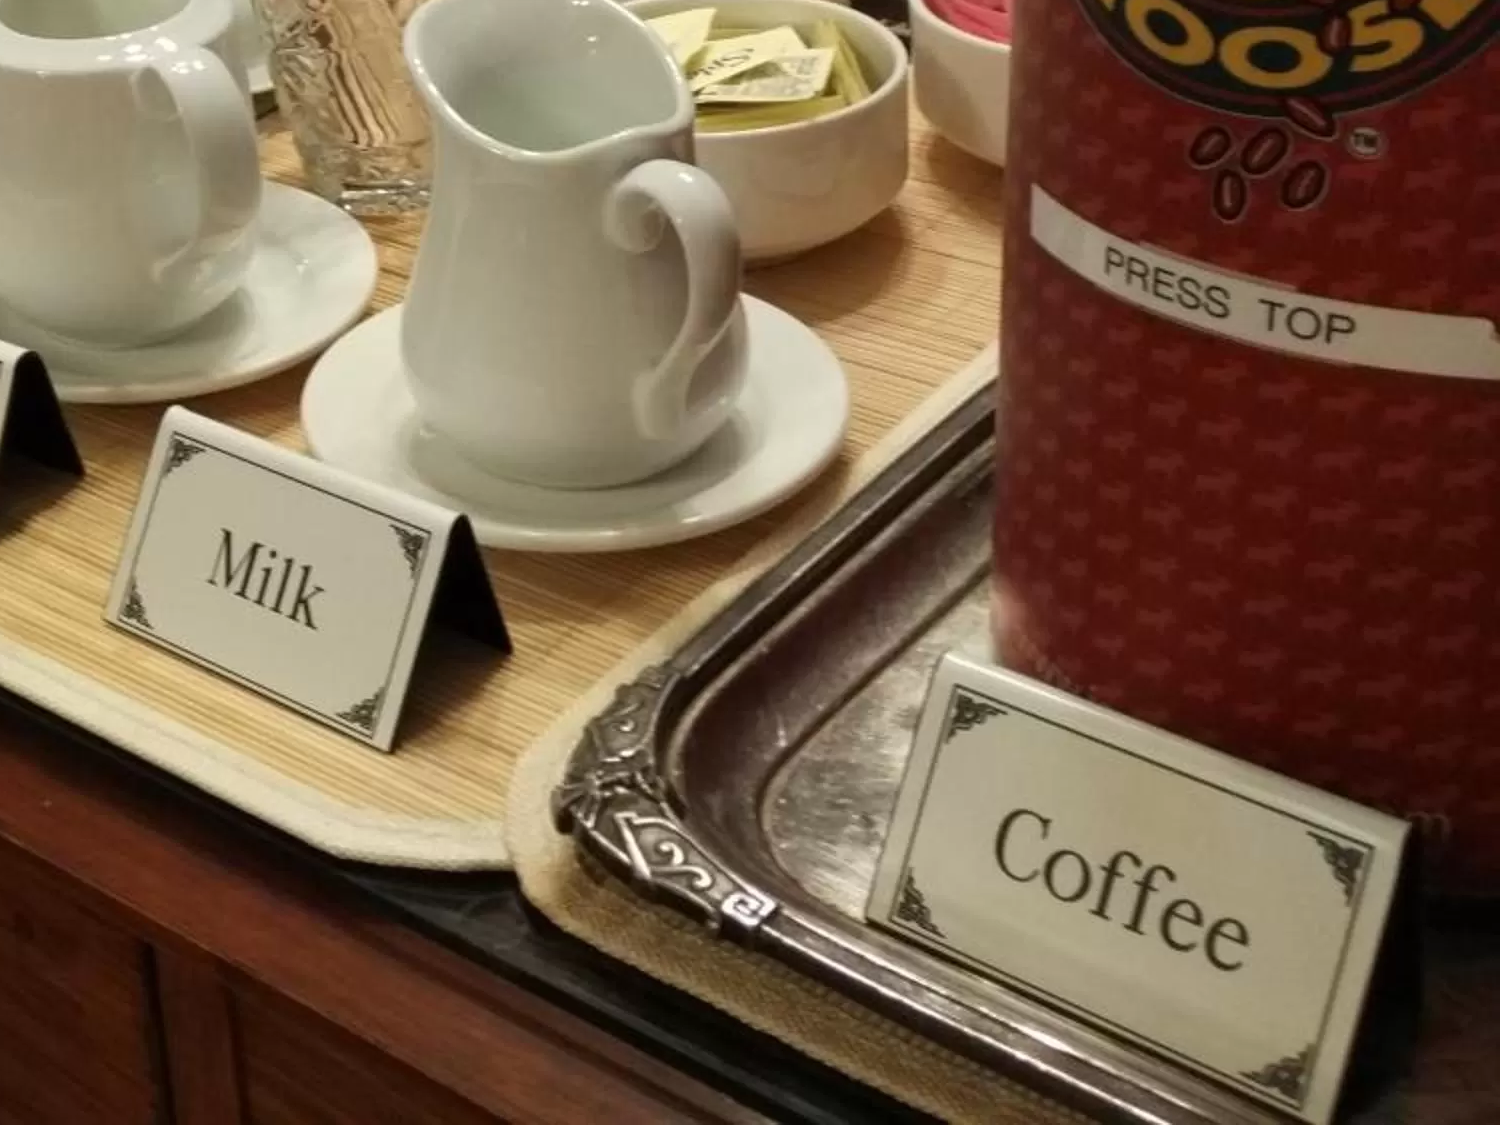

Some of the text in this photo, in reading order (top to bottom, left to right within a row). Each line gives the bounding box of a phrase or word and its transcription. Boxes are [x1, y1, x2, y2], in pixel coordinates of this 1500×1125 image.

[1103, 245, 1357, 345] PRESS TOP
[204, 527, 326, 632] Milk
[993, 807, 1250, 973] Coffee
